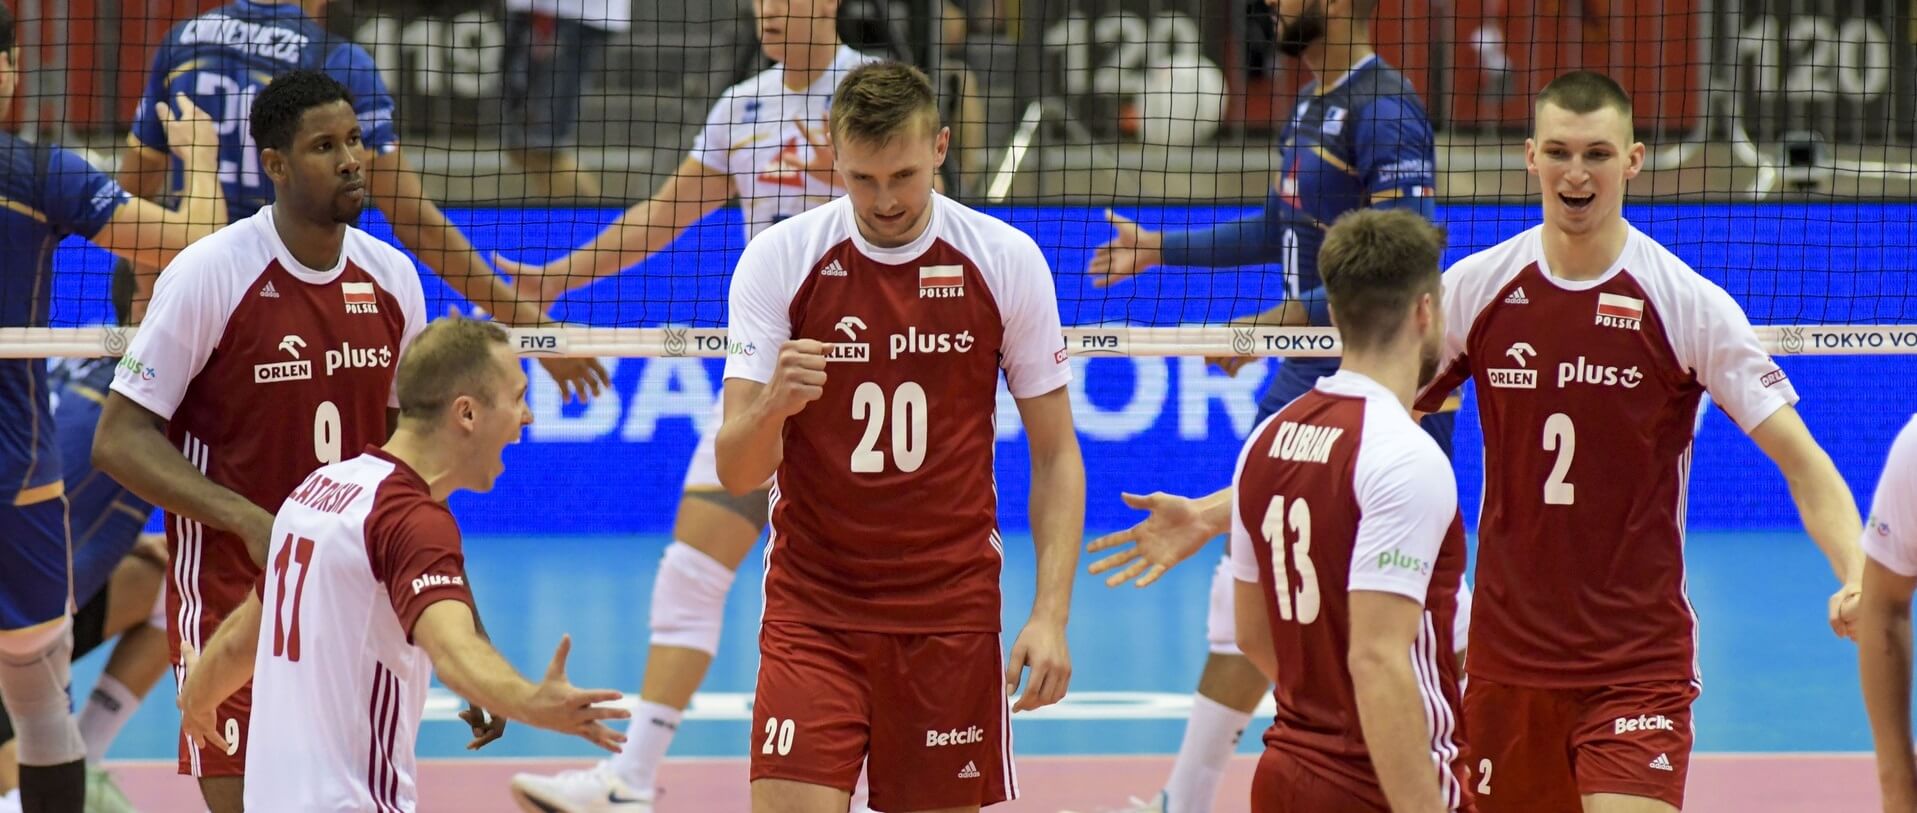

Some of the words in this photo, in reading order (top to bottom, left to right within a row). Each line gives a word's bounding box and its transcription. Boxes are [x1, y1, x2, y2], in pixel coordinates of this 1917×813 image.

[353, 13, 505, 97] 119
[1043, 11, 1200, 94] 120
[1738, 15, 1890, 101] 120
[821, 269, 848, 277] adidas
[345, 303, 379, 315] POLSKA
[919, 287, 965, 299] POLSKA
[1595, 315, 1641, 331] POLSKA
[520, 335, 557, 349] FIVB
[890, 326, 952, 360] plus
[1082, 335, 1119, 348] FIVB
[1263, 335, 1335, 351] TOKYO
[1812, 333, 1884, 349] TOKYO
[258, 363, 309, 380] ORLEN
[326, 342, 378, 376] plus
[1557, 356, 1619, 388] plus
[1490, 372, 1533, 385] ORLEN
[314, 400, 342, 465] 9
[850, 381, 928, 473] 20
[1268, 420, 1345, 464] KUBIAK
[1542, 412, 1576, 505] 2
[1261, 494, 1321, 625] 13
[1377, 548, 1421, 572] plus
[273, 532, 316, 662] 17
[411, 573, 451, 595] plus
[224, 717, 240, 756] 9
[761, 716, 796, 757] 20
[925, 724, 984, 747] Betclic
[1615, 713, 1674, 735] Betclic
[1477, 758, 1493, 796] 2
